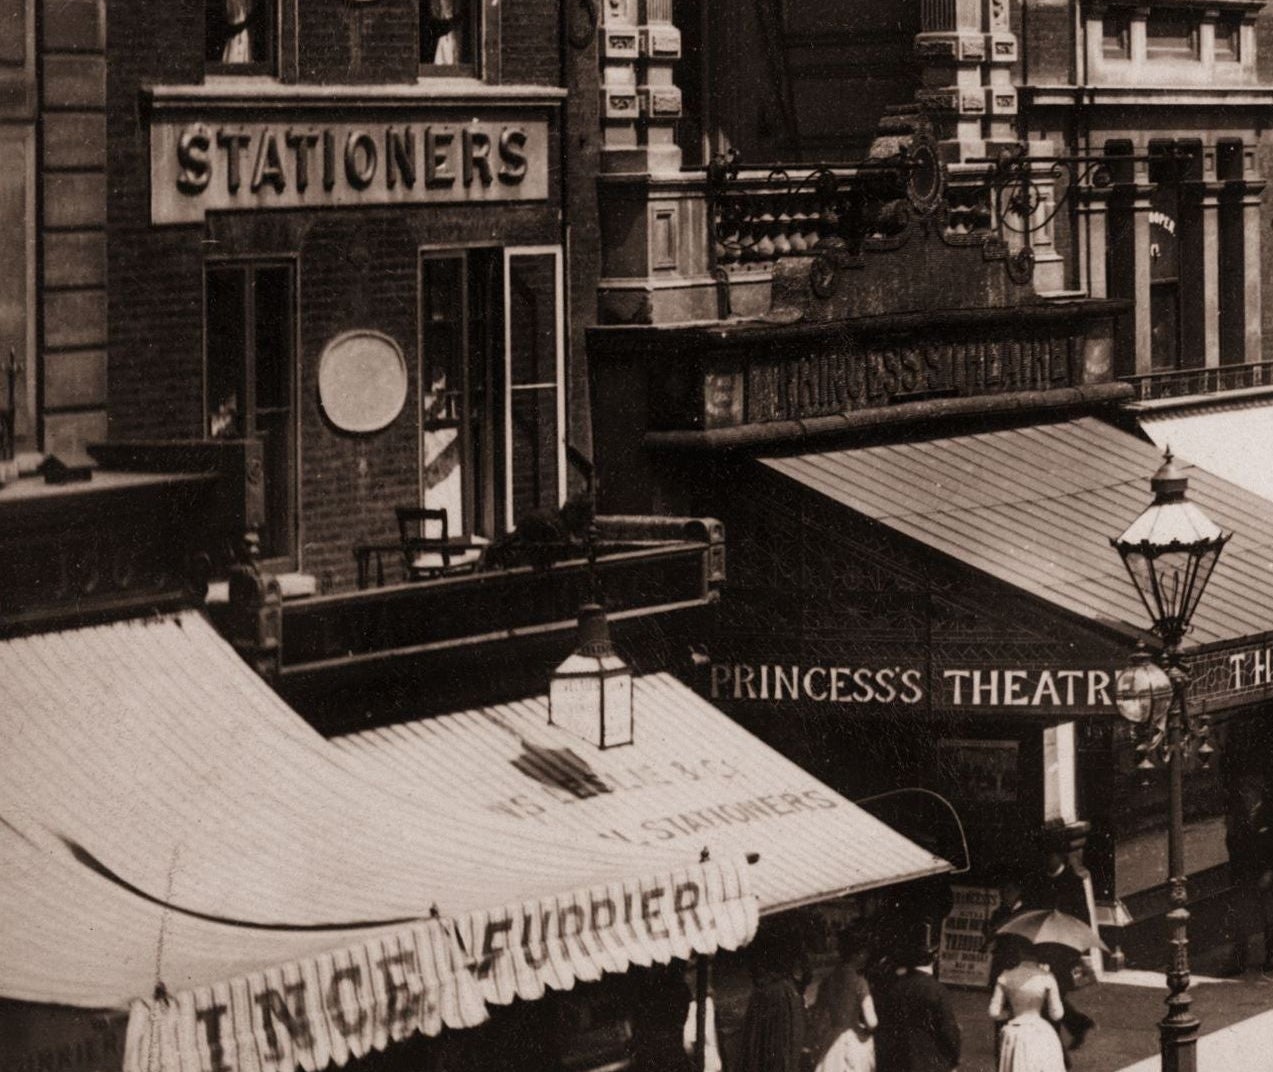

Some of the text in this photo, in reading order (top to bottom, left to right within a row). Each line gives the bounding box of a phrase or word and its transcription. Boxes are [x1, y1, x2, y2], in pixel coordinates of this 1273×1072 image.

[176, 122, 529, 197] STATIONERS
[709, 664, 924, 705] PRINCESS'S
[639, 788, 840, 841] STATIONERS
